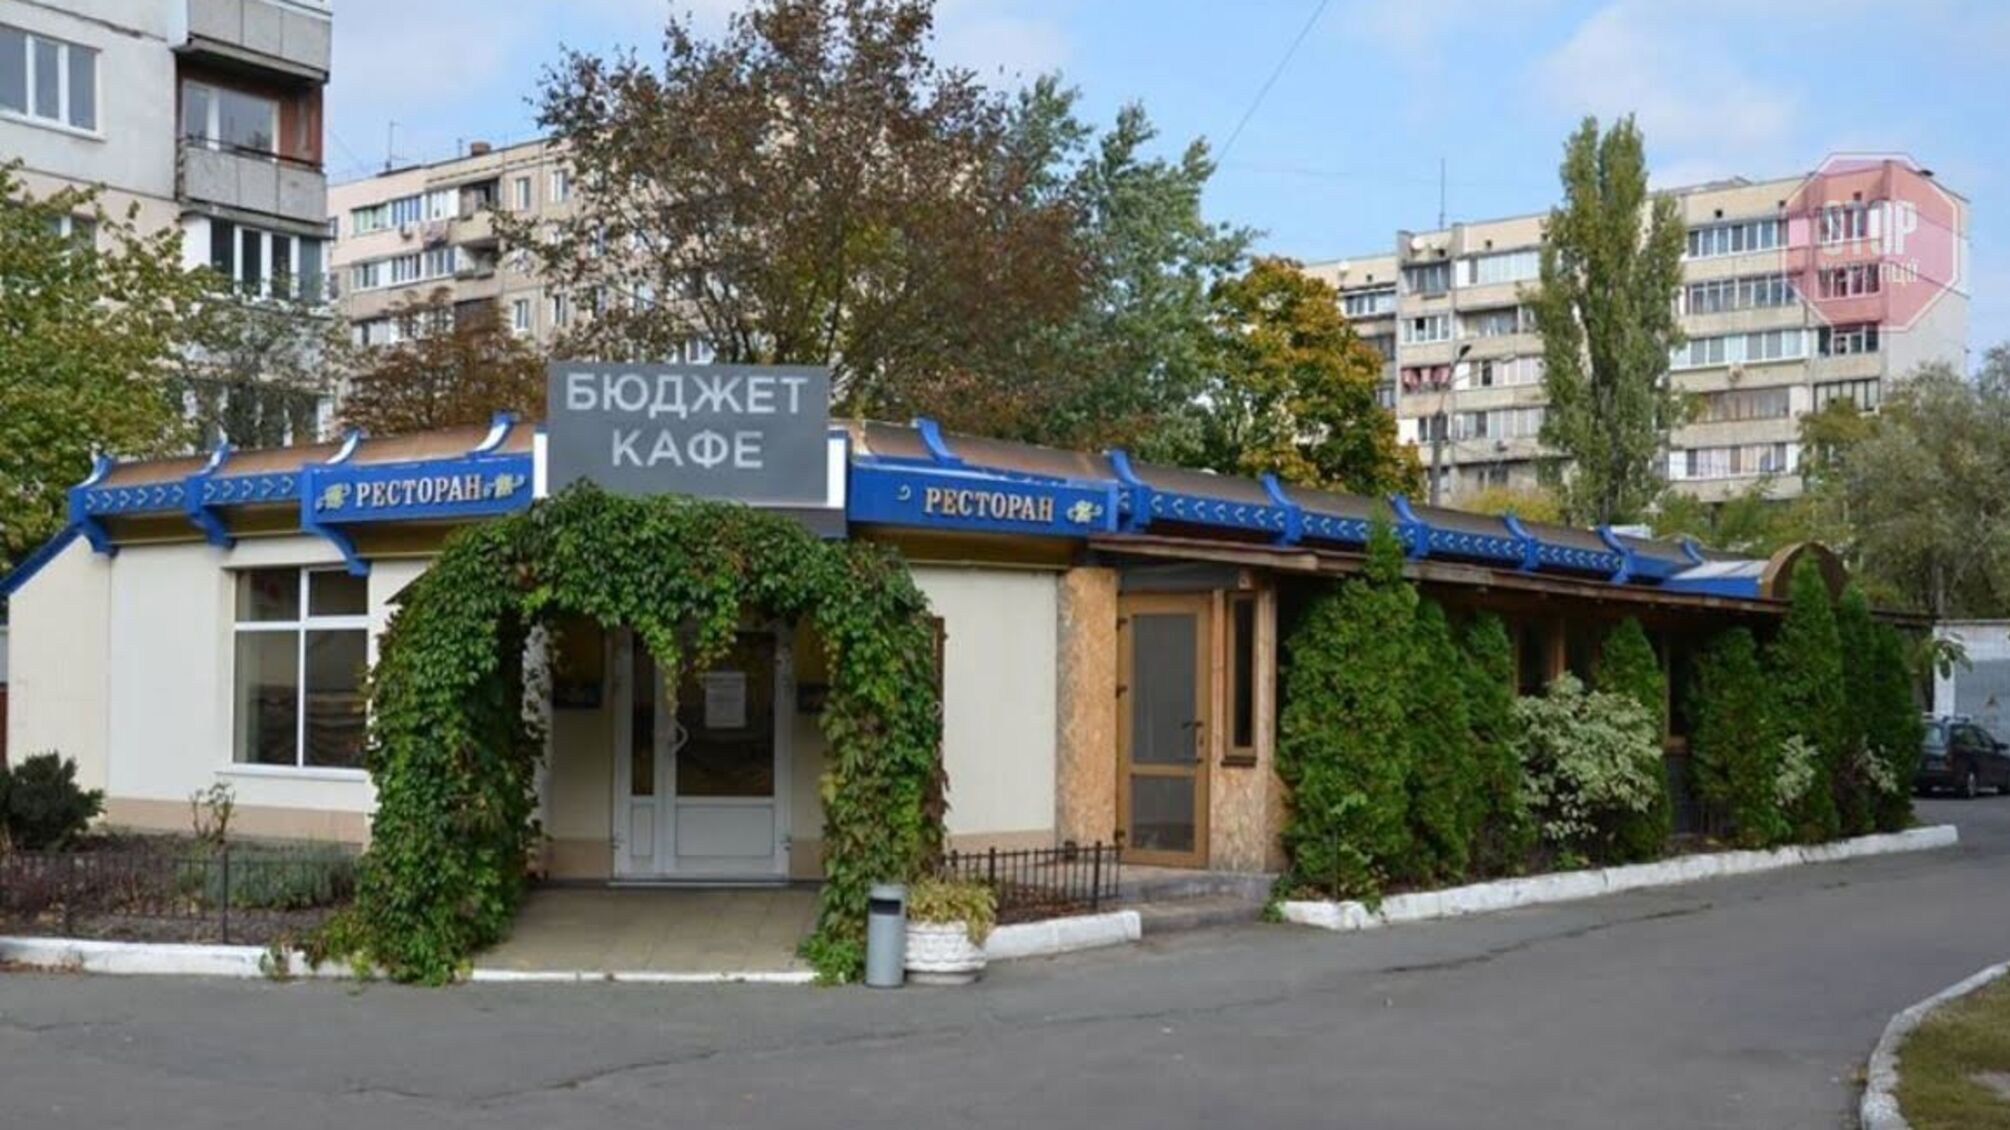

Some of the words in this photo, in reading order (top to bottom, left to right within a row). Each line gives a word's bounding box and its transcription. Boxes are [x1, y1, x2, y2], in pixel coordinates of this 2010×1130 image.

[566, 371, 808, 420] БЮДЖЕТ
[611, 427, 764, 469] КАФЕ
[355, 473, 482, 508] РЕСТОРАН
[924, 486, 1055, 523] РЕСТОРАН
